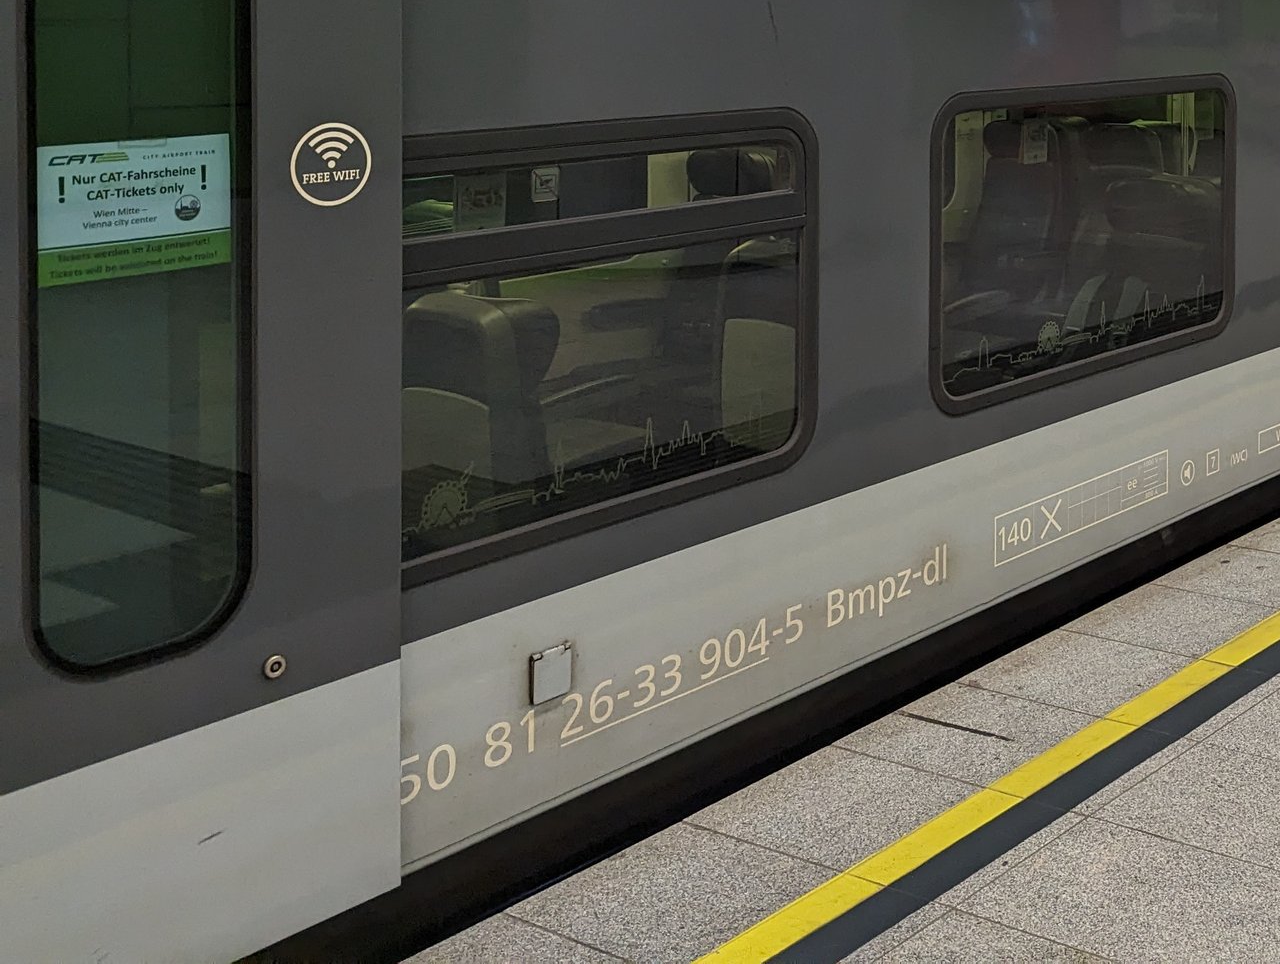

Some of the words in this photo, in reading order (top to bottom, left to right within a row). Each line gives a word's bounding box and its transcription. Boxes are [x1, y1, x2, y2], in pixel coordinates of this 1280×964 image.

[47, 152, 105, 167] CAT
[142, 153, 159, 161] CITY
[162, 150, 193, 159] AIRPORT
[72, 174, 96, 186] Nur
[99, 165, 197, 184] CAT-Fahrscheine
[302, 171, 331, 185] FREE
[332, 168, 361, 182] WIFI
[86, 186, 157, 201] CAT-Tickets
[159, 183, 185, 196] only
[92, 208, 116, 219] Wien
[117, 206, 140, 217] Mitte
[82, 219, 112, 231] Vienna
[113, 217, 128, 228] city
[130, 215, 158, 226] center
[145, 241, 163, 254] Zug
[1230, 448, 1248, 467] (WC)
[1127, 478, 1138, 491] ee
[998, 517, 1032, 551] 140
[400, 743, 457, 806] 50
[484, 709, 535, 768] 81
[560, 653, 683, 740] 26-33
[700, 603, 804, 680] 904-5
[826, 543, 947, 628] Bmpz-dl
